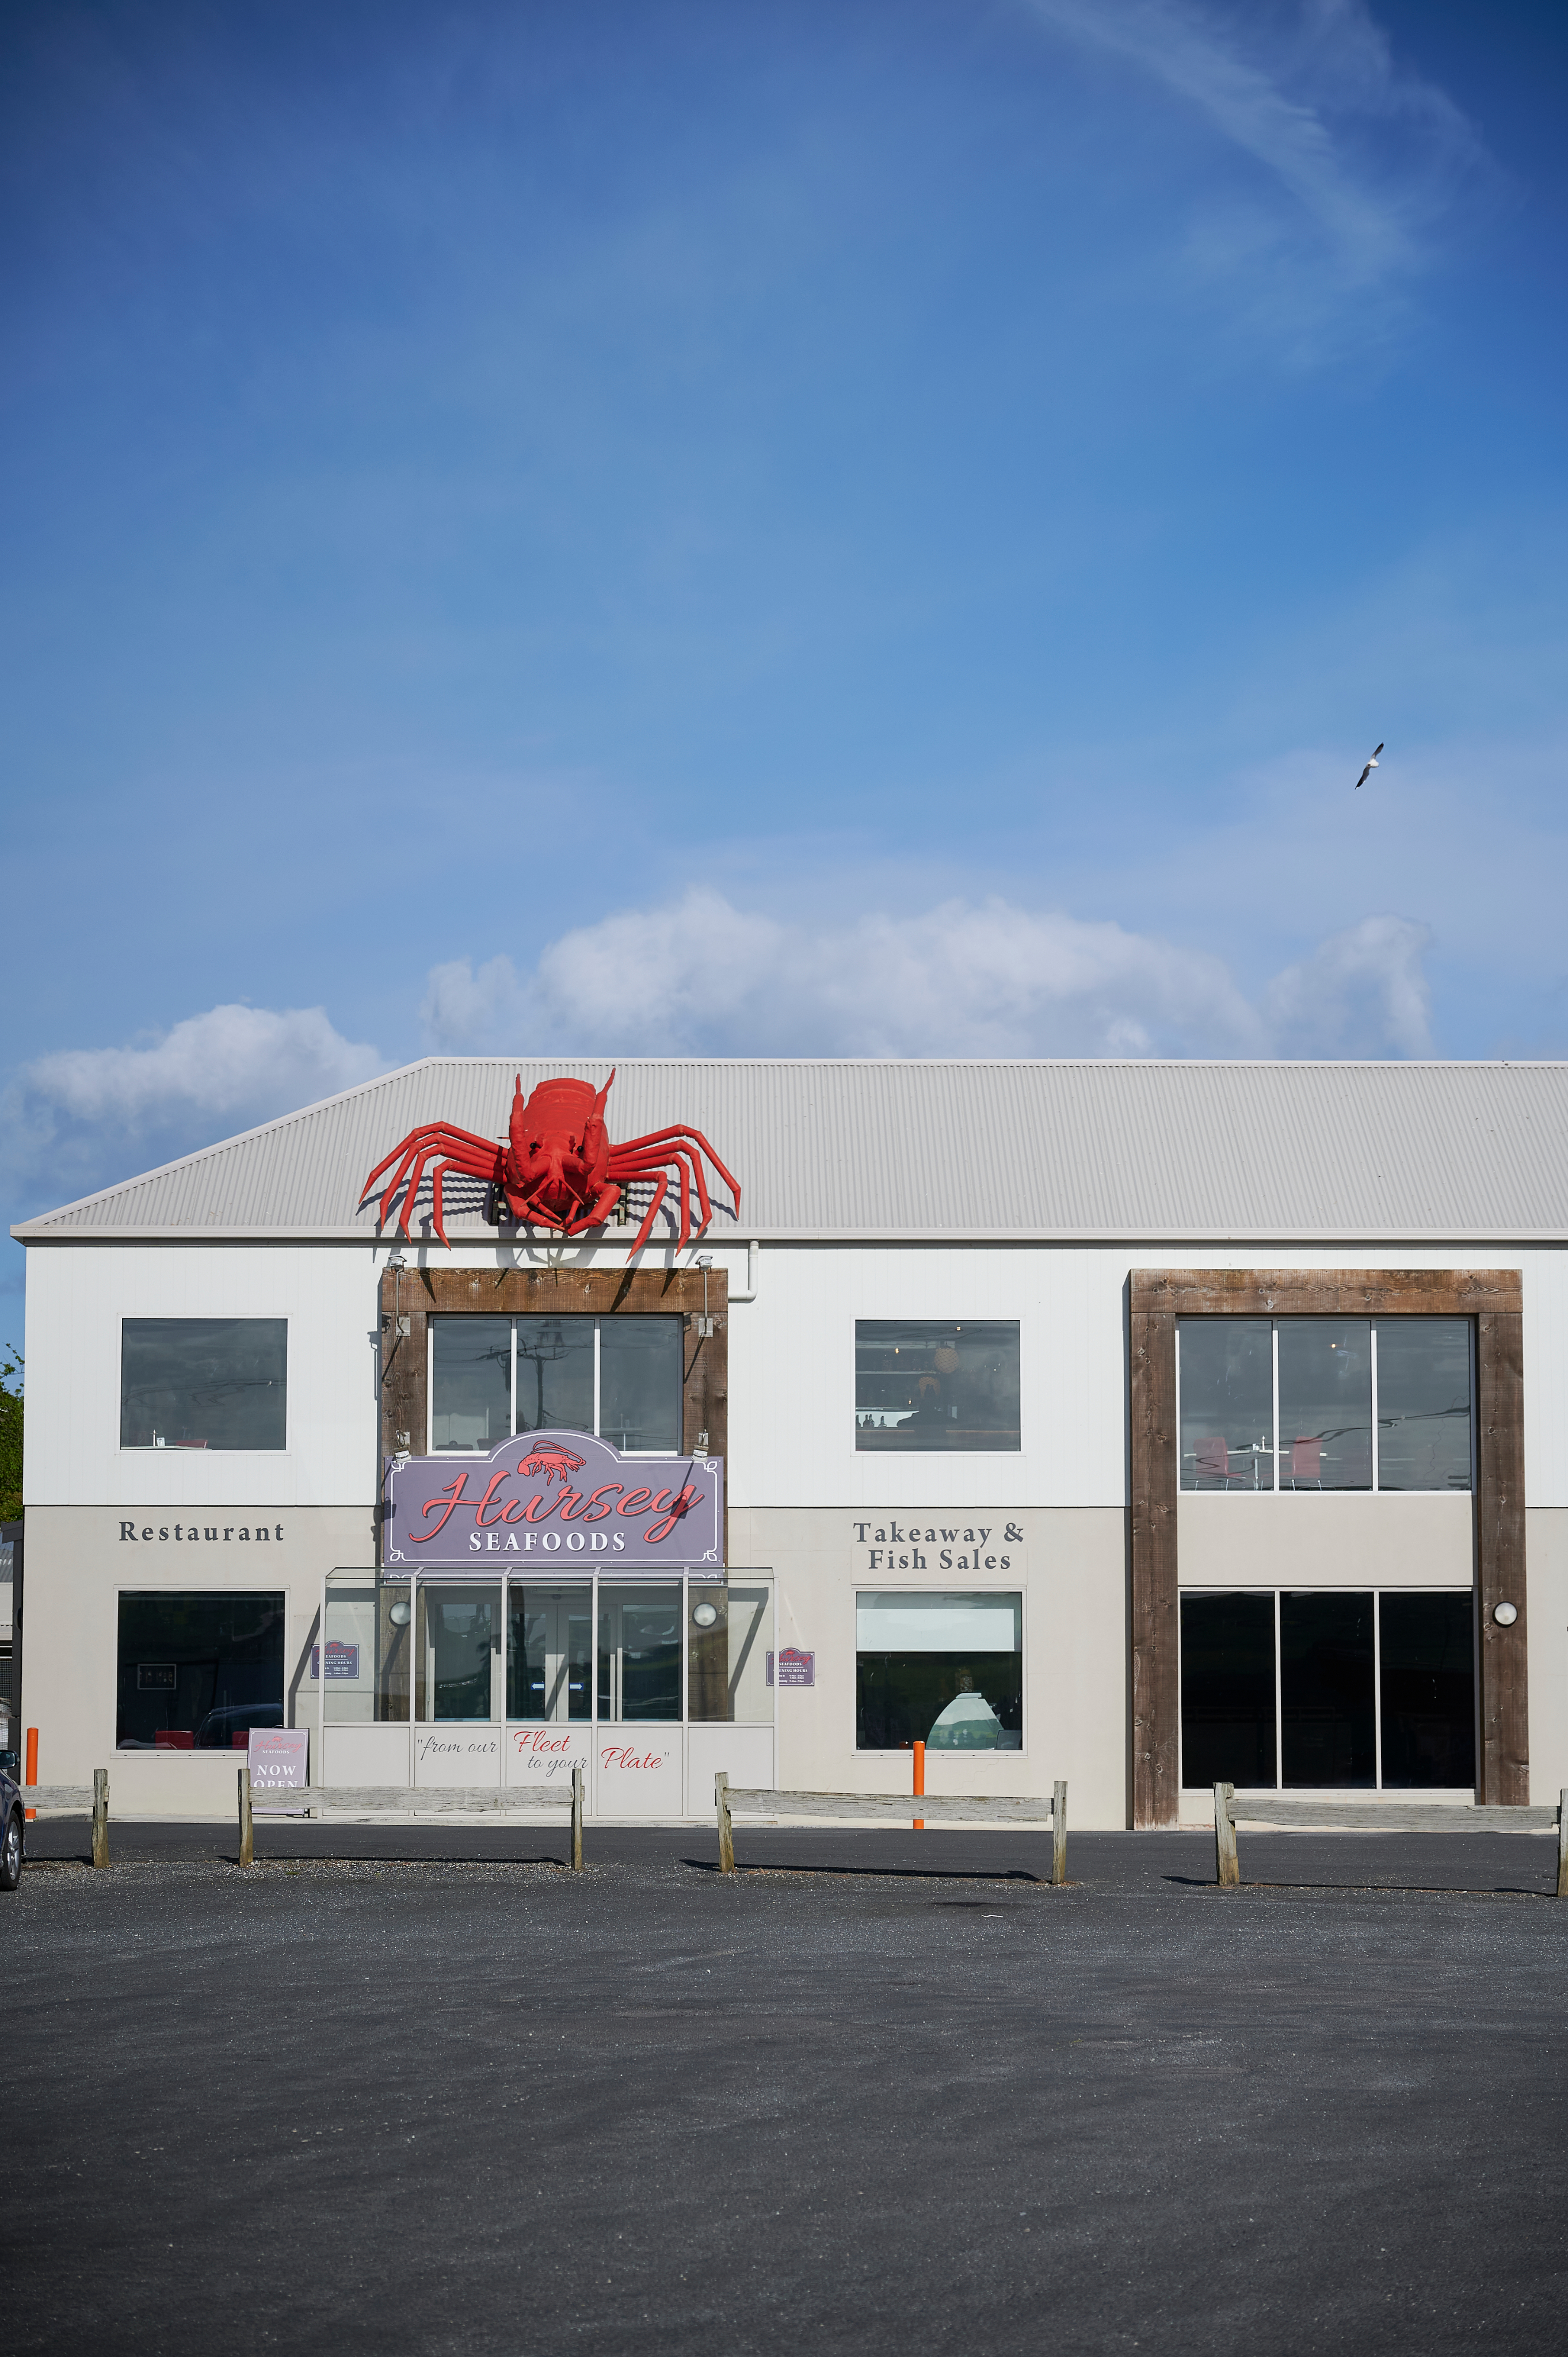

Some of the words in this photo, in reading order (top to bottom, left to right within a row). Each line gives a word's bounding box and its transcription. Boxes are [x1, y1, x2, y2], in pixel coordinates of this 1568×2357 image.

[408, 1470, 705, 1543] Hursey
[119, 1521, 284, 1541] Restaurant
[853, 1521, 993, 1549] Takeaway
[1004, 1522, 1024, 1543] &
[468, 1532, 626, 1552] SEAFOODS
[868, 1548, 928, 1569] Fish
[939, 1548, 1011, 1569] Sales
[253, 1740, 304, 1753] Hursey
[468, 1741, 498, 1753] our
[513, 1730, 571, 1752] Fleet
[257, 1765, 297, 1776] NOW
[528, 1756, 544, 1768] to
[545, 1757, 589, 1778] your
